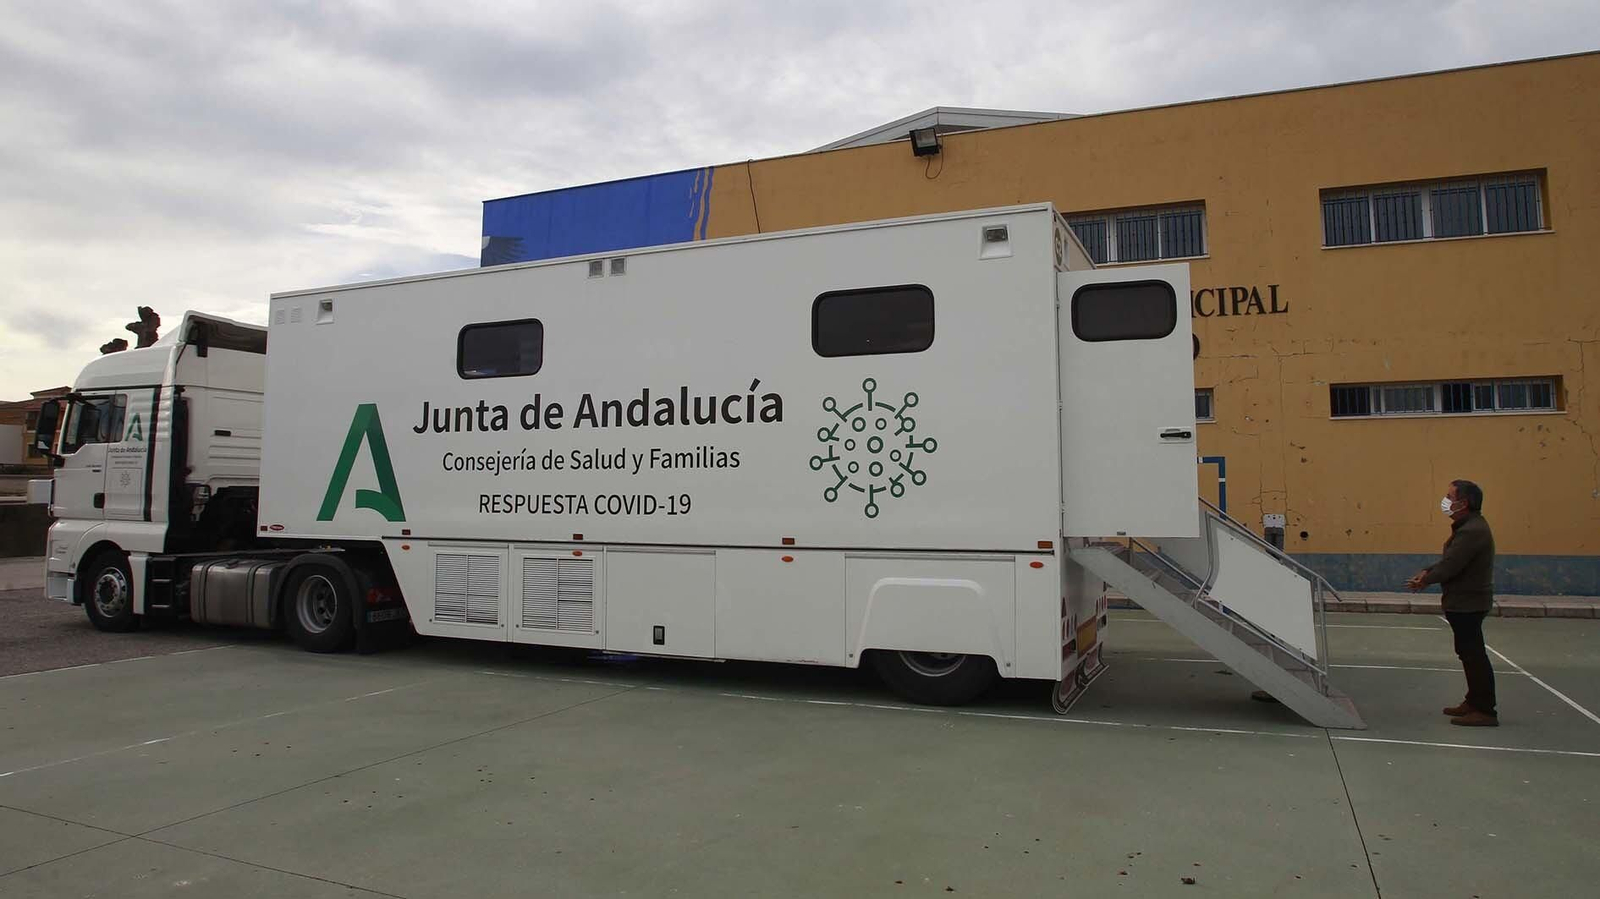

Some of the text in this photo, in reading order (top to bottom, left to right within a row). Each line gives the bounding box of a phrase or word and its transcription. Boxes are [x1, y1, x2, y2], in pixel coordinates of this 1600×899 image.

[412, 378, 784, 434] Junta de Andalucía
[442, 446, 741, 476] Consejería de Salud y Familias
[479, 493, 692, 515] RESPUESTA COVID-19
